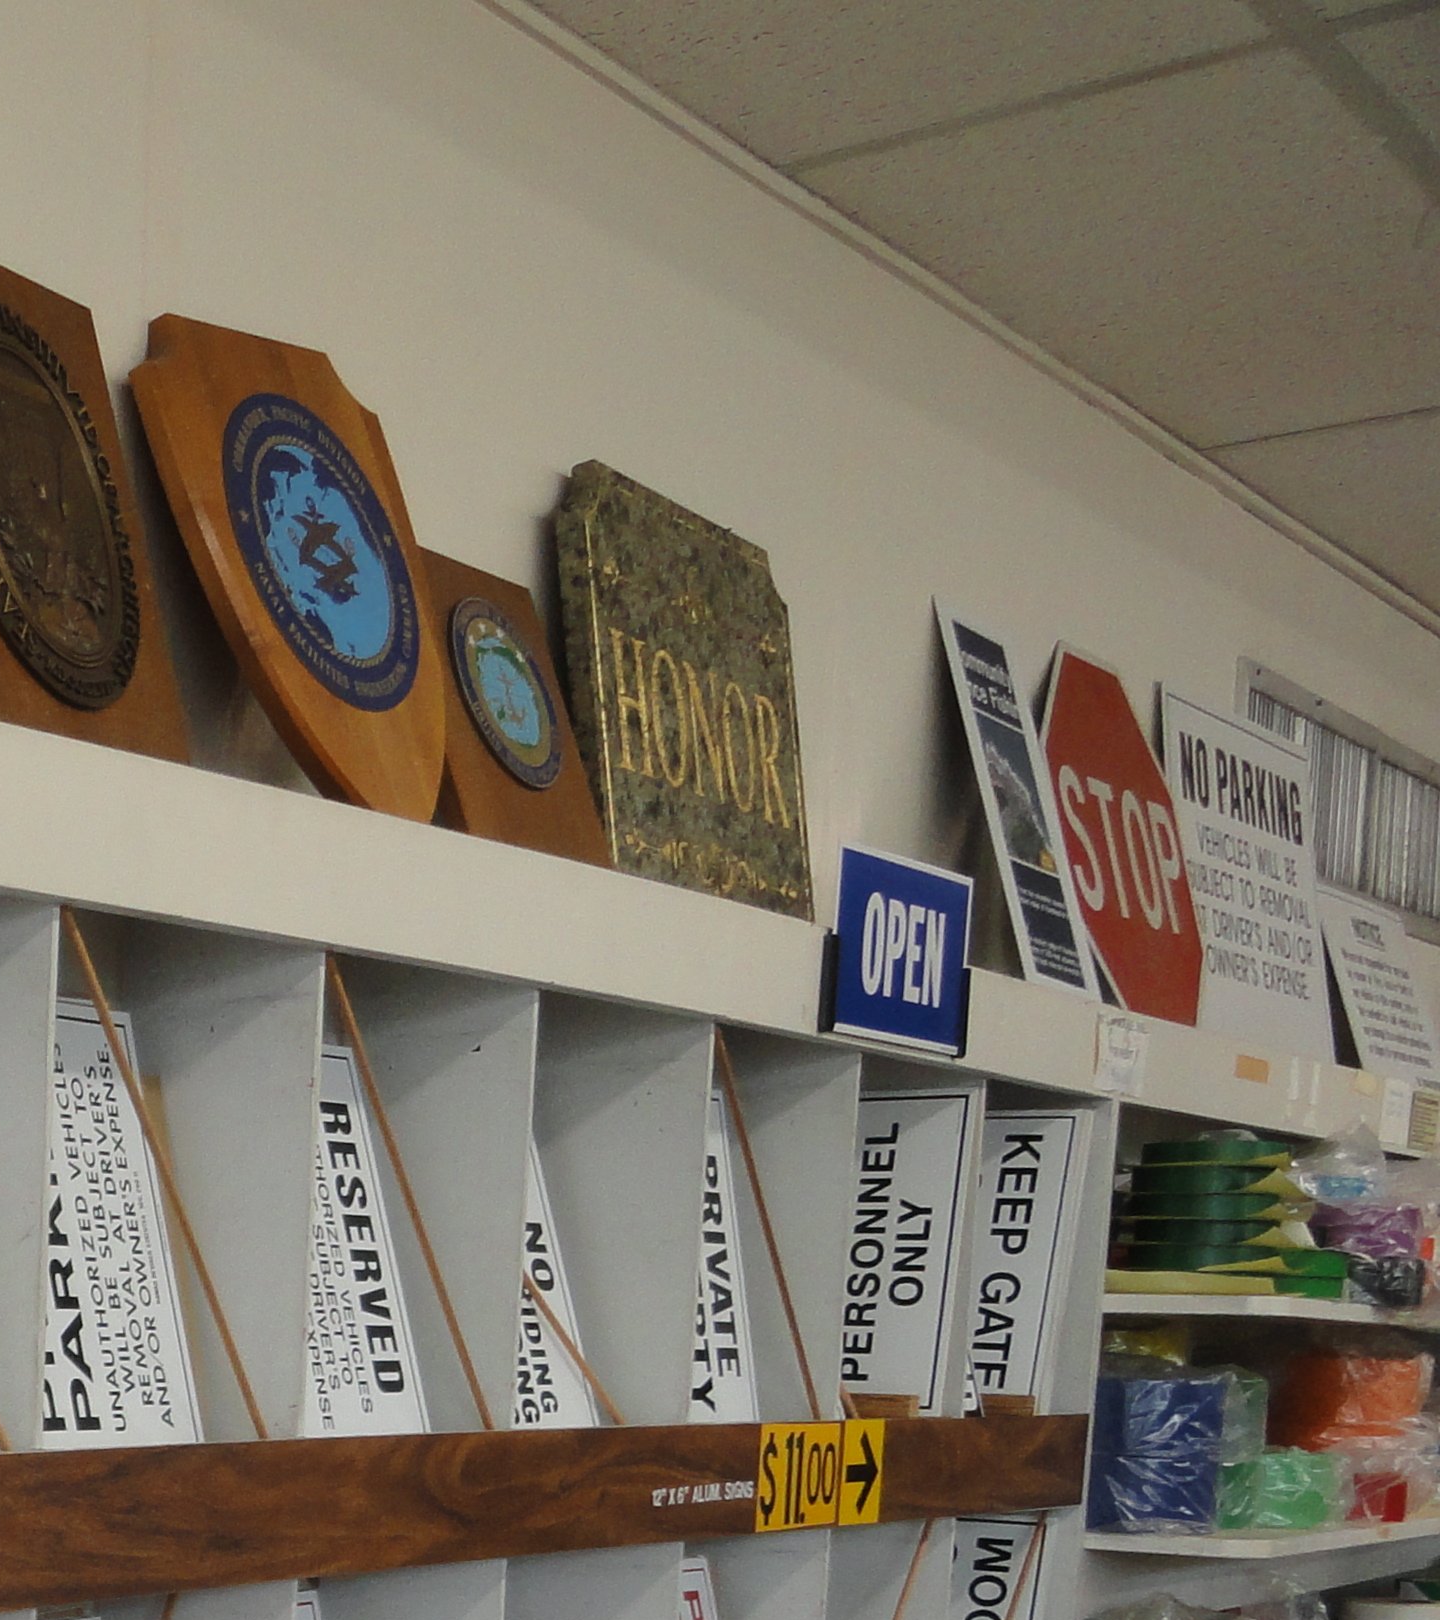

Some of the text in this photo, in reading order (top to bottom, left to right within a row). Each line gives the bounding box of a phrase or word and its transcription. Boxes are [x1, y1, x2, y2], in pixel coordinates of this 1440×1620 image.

[610, 627, 791, 829] HONOR
[1179, 731, 1303, 846] NO PARKING
[1058, 764, 1180, 934] STOP
[860, 891, 947, 1009] OPEN
[83, 1066, 118, 1196] DRIVER'S
[80, 1134, 135, 1393] WILL SUBJECT
[121, 1180, 152, 1309] OWNER'S
[312, 1224, 345, 1342] SUBJECT
[320, 1100, 405, 1394] RESERVED
[525, 1222, 555, 1292] NO
[841, 1122, 900, 1382] PERSONNEL
[888, 1198, 934, 1307] ONLY
[971, 1134, 1044, 1390] KEEP GATE
[74, 1196, 127, 1433] UNAUTHORIZED
[118, 1261, 155, 1407] REMOVAL
[144, 1316, 175, 1429] AND/OR
[341, 1289, 374, 1414] VEHICLES
[724, 1481, 754, 1500] SIGNS
